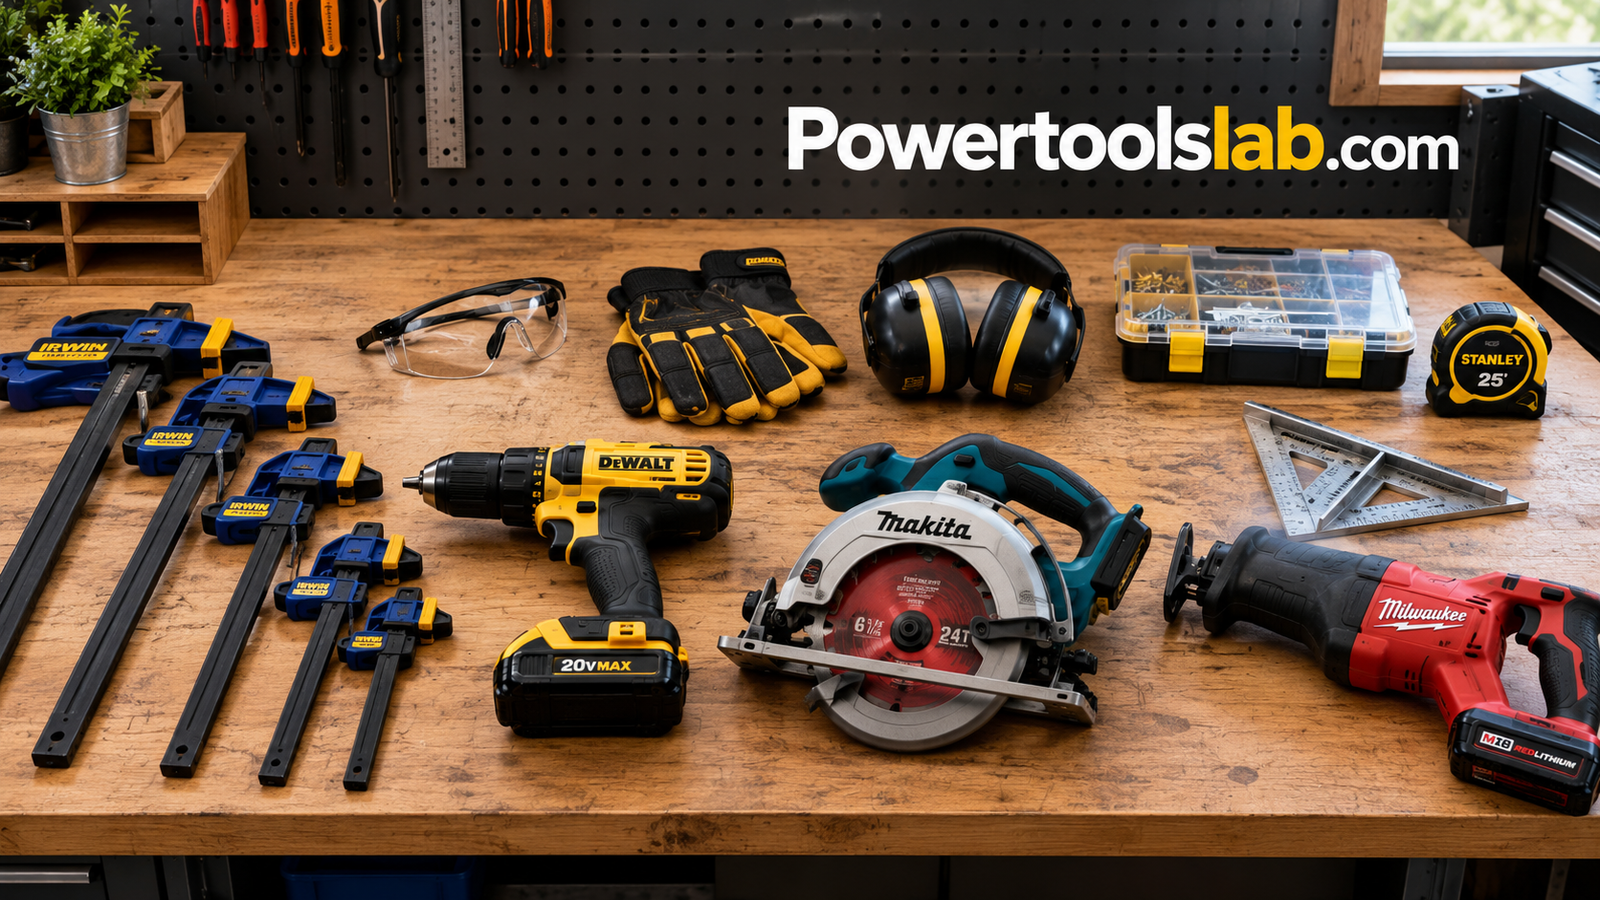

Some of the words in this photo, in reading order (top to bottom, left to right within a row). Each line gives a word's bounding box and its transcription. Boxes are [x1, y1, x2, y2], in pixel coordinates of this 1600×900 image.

[38, 342, 109, 352] IRWIN
[1461, 353, 1524, 366] STANLEY
[1477, 372, 1508, 387] 25'
[151, 431, 195, 440] IRWIN
[229, 501, 271, 511] IRWIN
[877, 510, 972, 540] Makita
[1378, 597, 1467, 621] Milwaukee
[940, 626, 970, 643] 24T
[1513, 744, 1577, 769] REDLITHIUM
